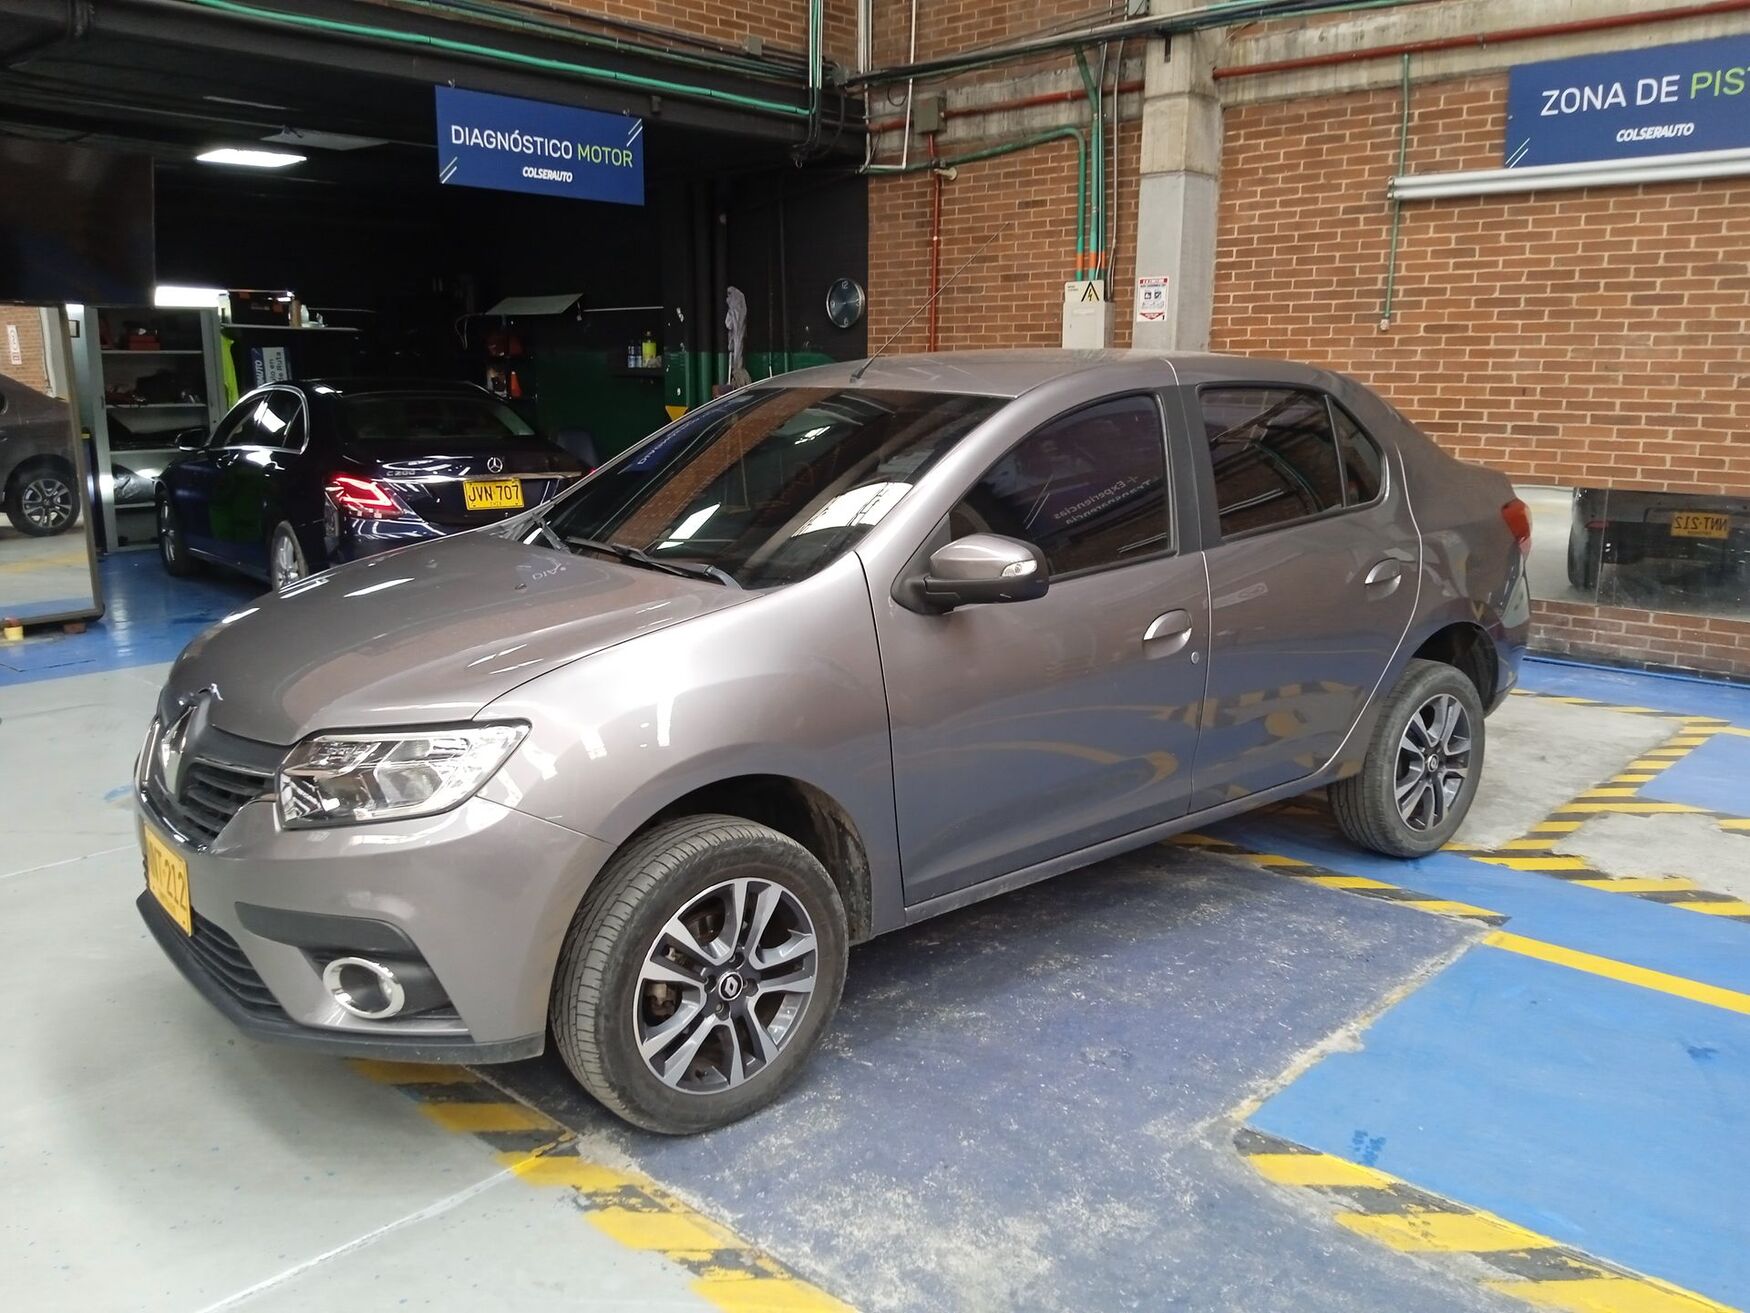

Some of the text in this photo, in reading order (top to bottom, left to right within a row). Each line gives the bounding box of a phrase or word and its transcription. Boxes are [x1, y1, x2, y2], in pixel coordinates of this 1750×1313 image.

[1540, 66, 1750, 117] ZONA DE PIS
[1616, 122, 1695, 143] COLSERAUTO
[451, 125, 633, 168] DIAGNÓSTICO MOTOR
[522, 166, 573, 183] COLSERAUTO
[468, 484, 519, 502] JVN 707
